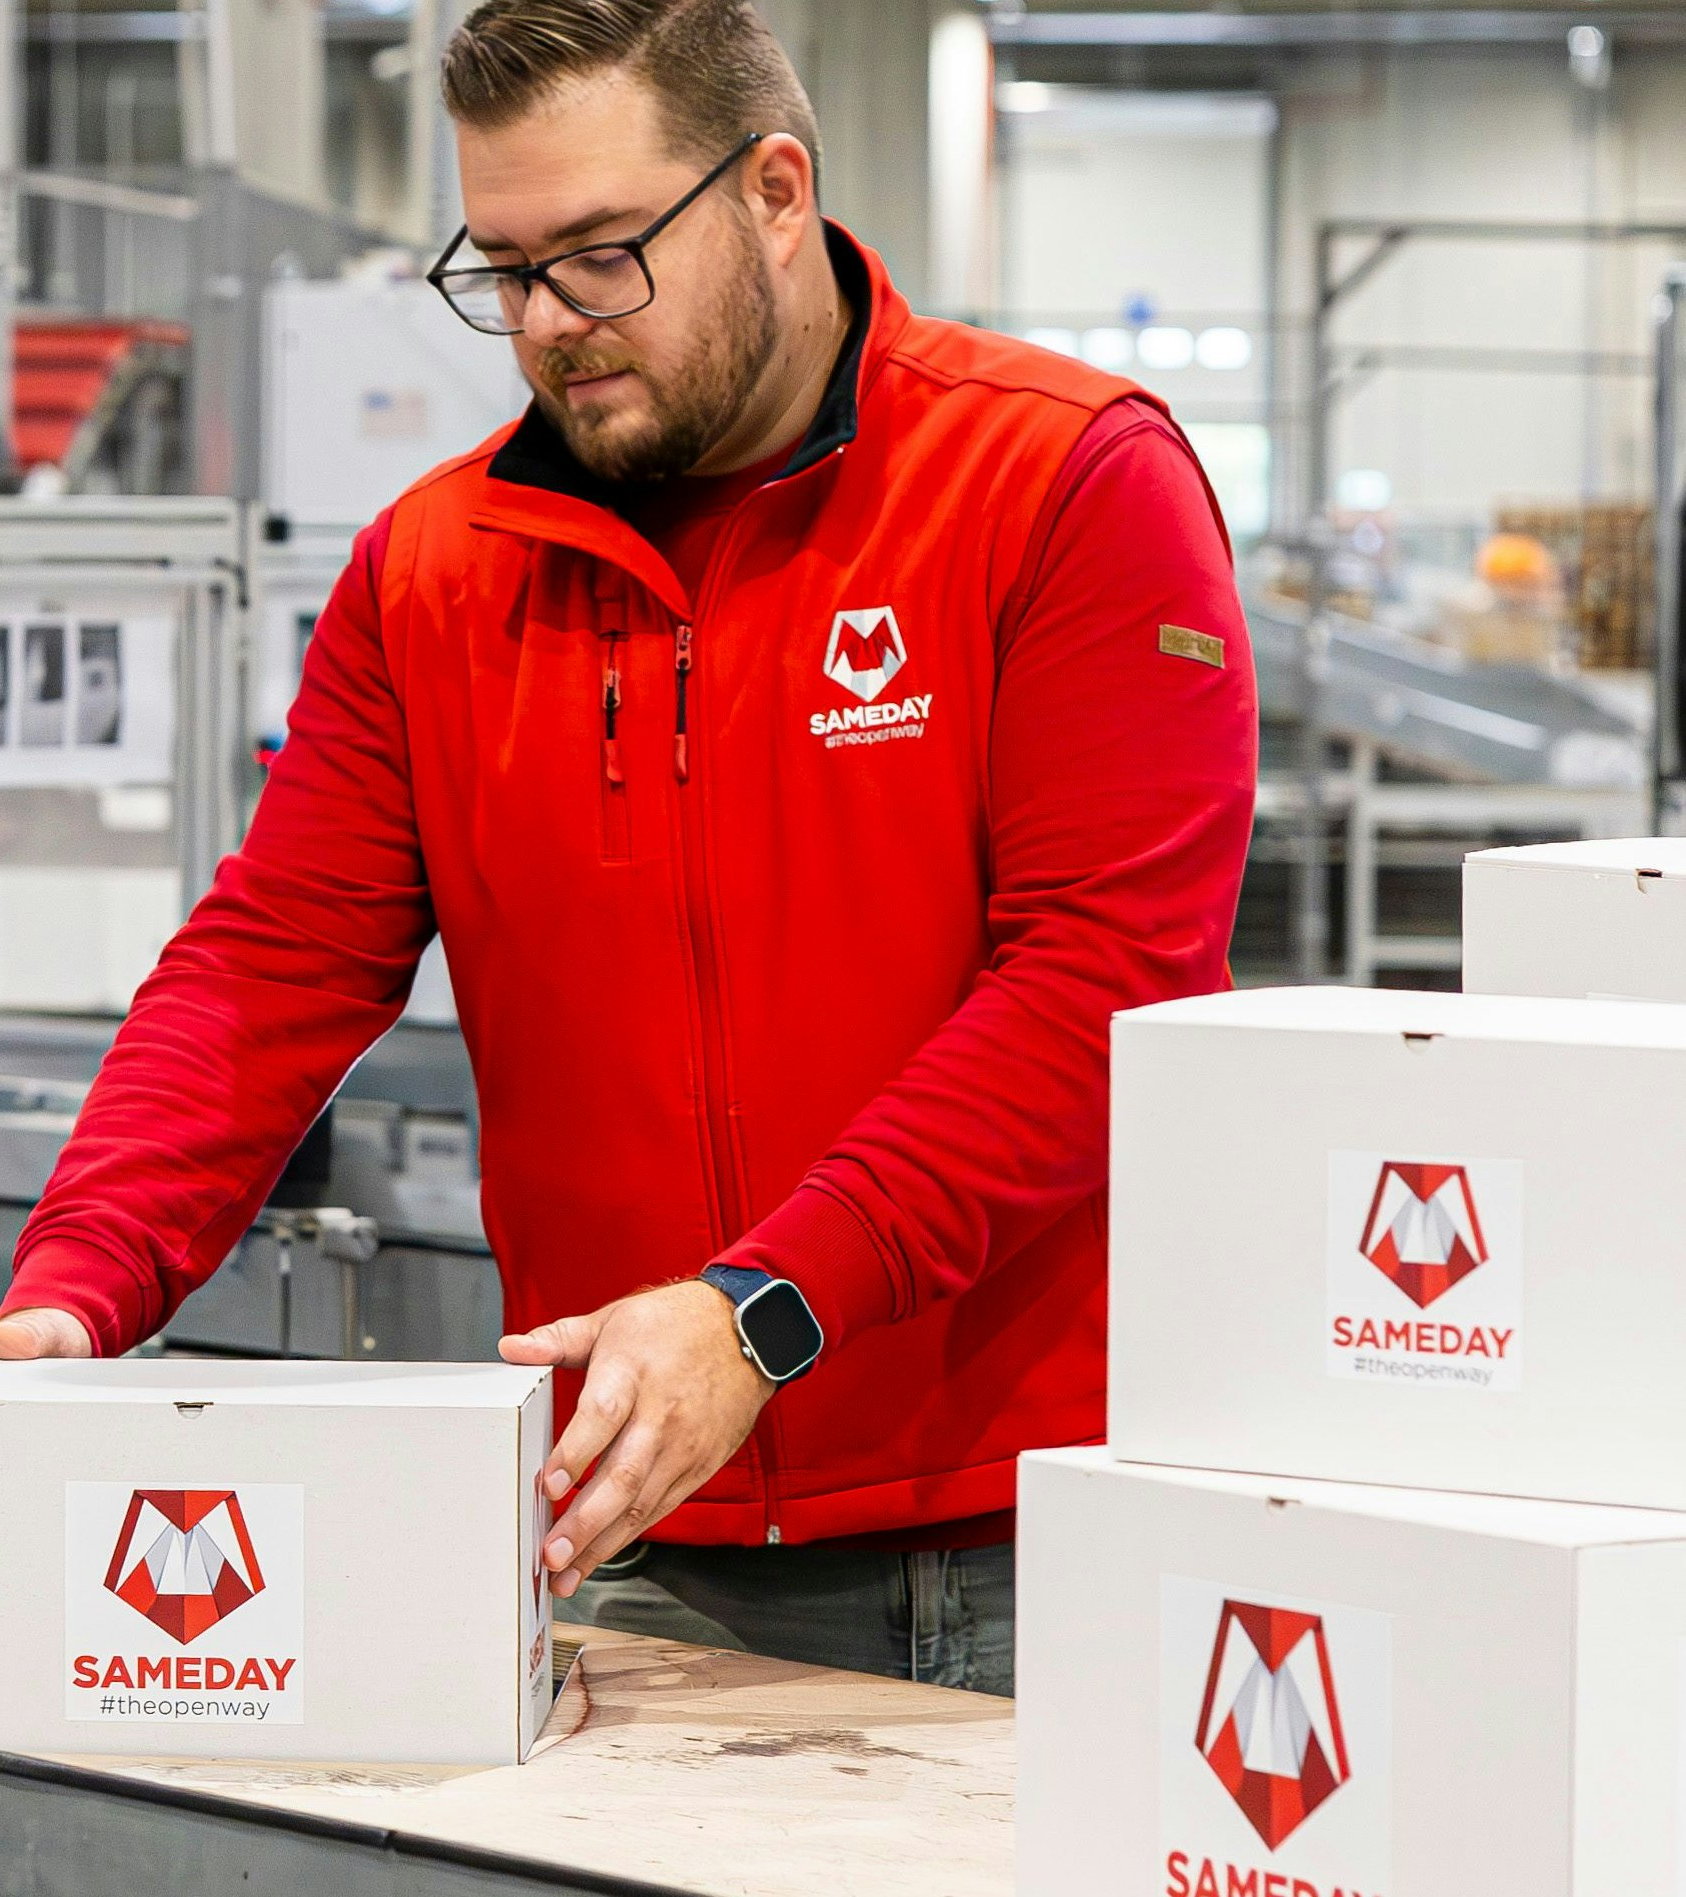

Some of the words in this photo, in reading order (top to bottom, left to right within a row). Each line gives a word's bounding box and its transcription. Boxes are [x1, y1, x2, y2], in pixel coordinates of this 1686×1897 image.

[809, 693, 933, 735] SAMEDAY
[1332, 1315, 1515, 1359] SAMEDAY
[1353, 1356, 1494, 1387] #theopenway
[72, 1655, 296, 1691] SAMEDAY
[99, 1696, 270, 1720] #theopenway
[1166, 1850, 1384, 1897] SAME
